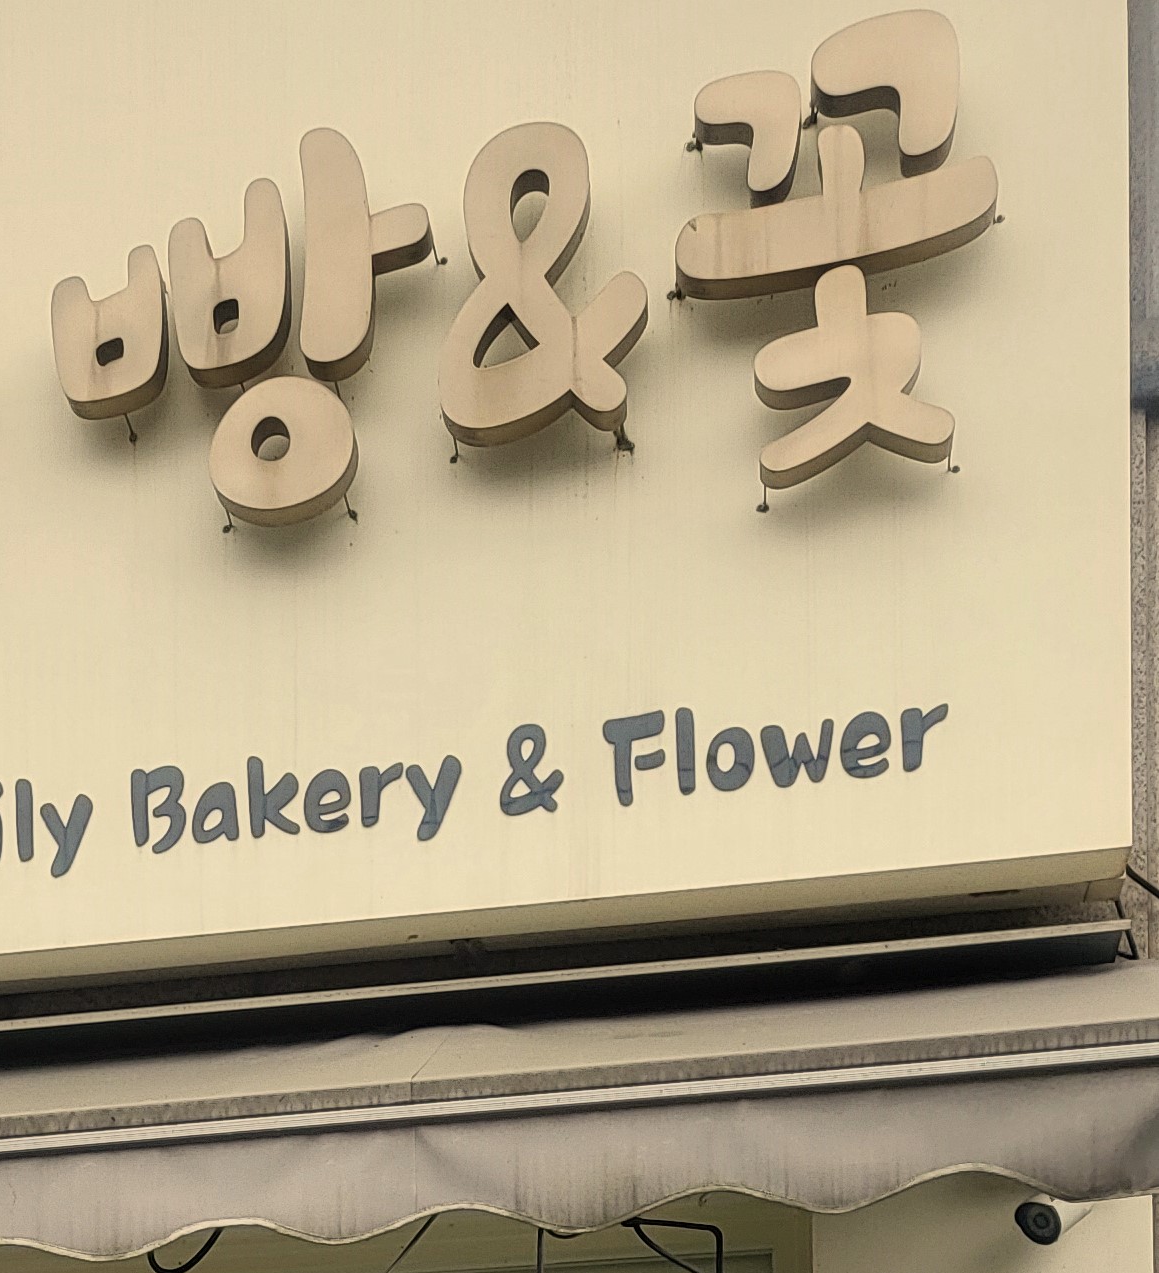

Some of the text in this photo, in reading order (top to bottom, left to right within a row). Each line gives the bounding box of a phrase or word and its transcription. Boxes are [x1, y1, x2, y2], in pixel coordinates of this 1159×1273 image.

[51, 9, 998, 527] 빵&꽃
[131, 756, 462, 854] Bakery
[500, 724, 564, 817] &
[603, 703, 949, 806] Flower
